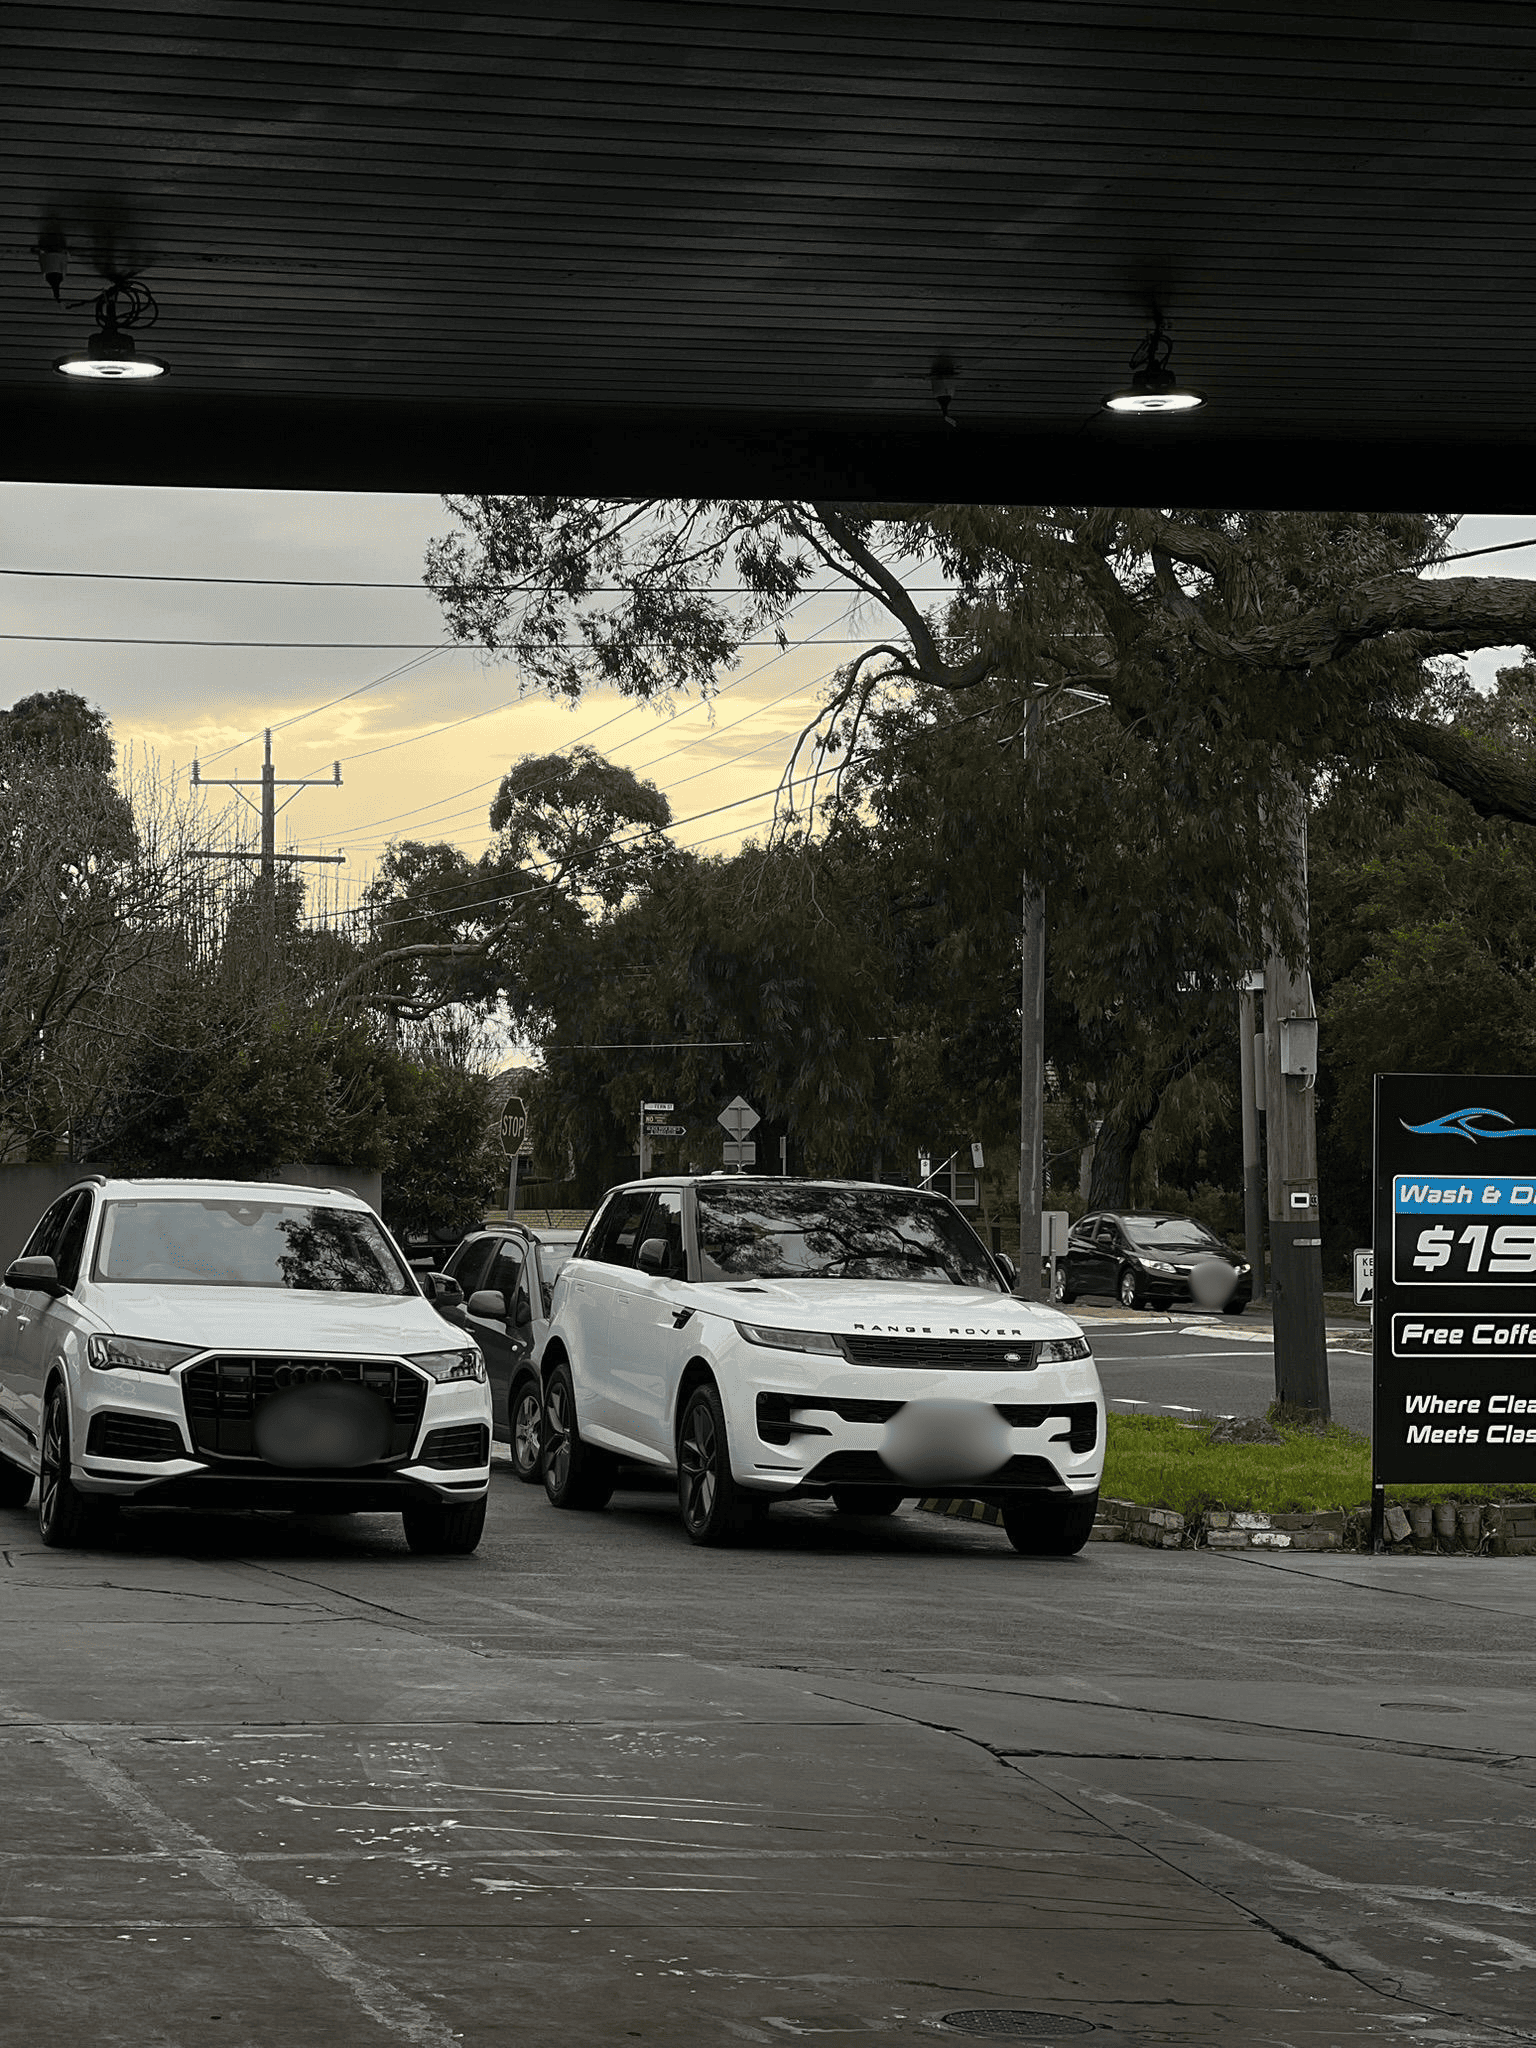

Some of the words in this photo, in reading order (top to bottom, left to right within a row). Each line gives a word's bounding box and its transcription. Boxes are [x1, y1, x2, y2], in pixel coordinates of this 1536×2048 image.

[502, 1115, 524, 1137] STOP
[1400, 1184, 1473, 1203] Wash
[1481, 1186, 1501, 1204] &
[1510, 1186, 1536, 1204] D
[1413, 1225, 1536, 1272] $19
[1362, 1257, 1373, 1266] KE
[1363, 1268, 1373, 1276] LE
[854, 1323, 931, 1333] RANGE
[1401, 1323, 1464, 1344] Free
[1405, 1395, 1481, 1413] Where
[1488, 1395, 1536, 1413] Clea
[1406, 1425, 1480, 1443] Meets
[1486, 1425, 1536, 1443] Clas
